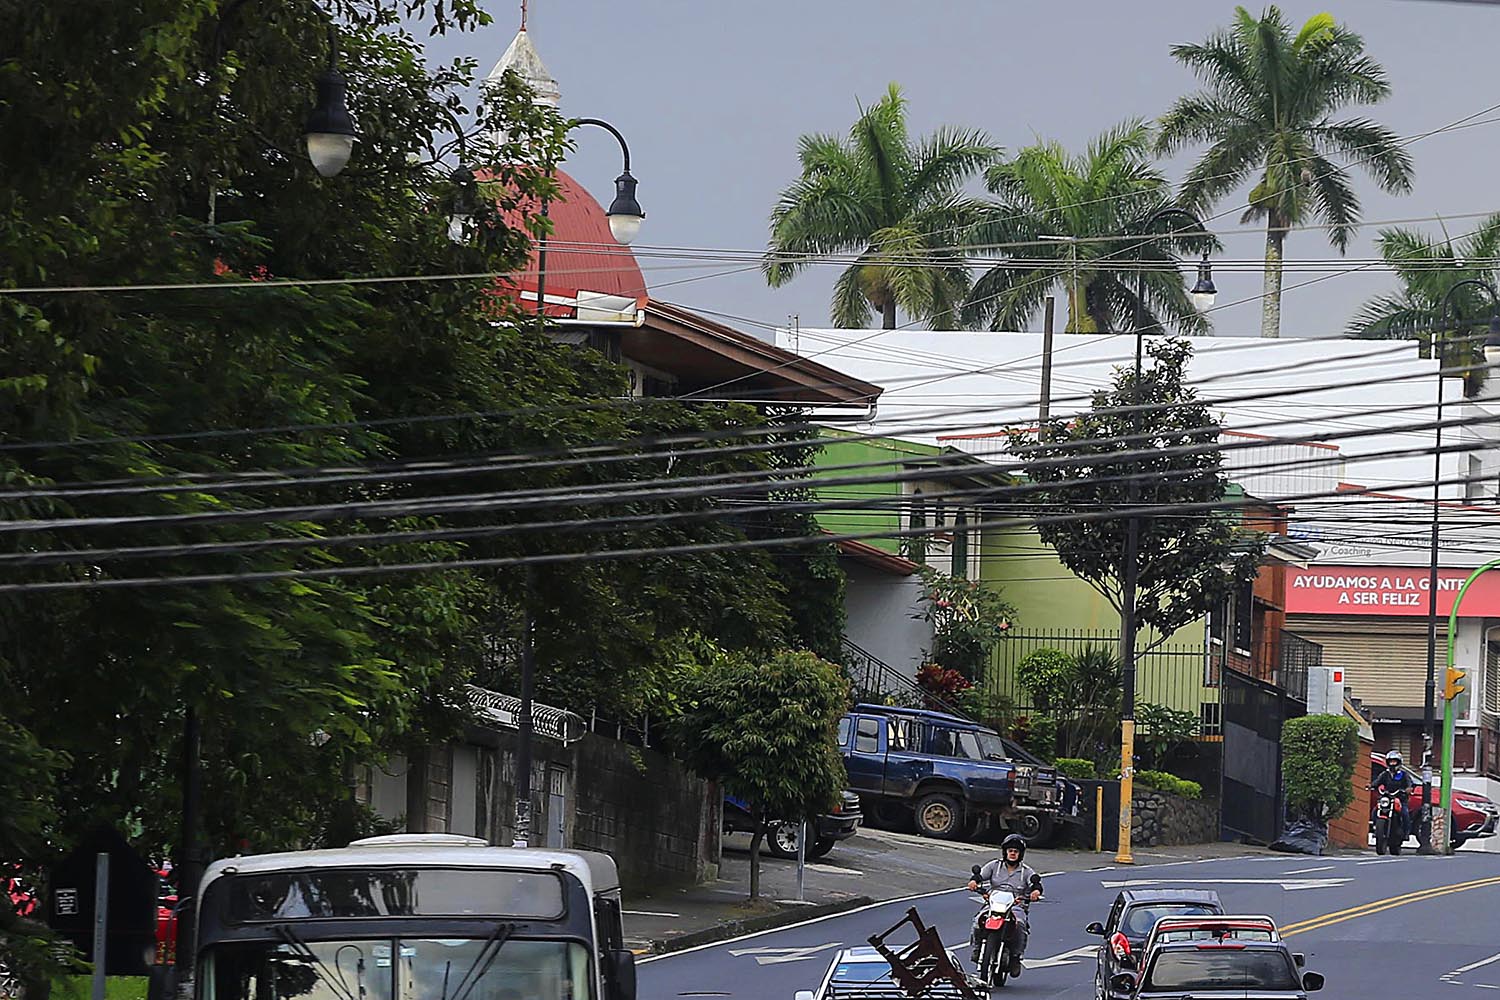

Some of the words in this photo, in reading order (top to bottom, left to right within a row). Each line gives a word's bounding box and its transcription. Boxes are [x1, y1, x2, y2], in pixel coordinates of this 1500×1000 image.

[1331, 545, 1371, 557] Coaching
[1293, 576, 1377, 589] AYUDAMOS
[1380, 577, 1393, 590] A
[1396, 578, 1415, 590] LA
[1418, 578, 1466, 591] GNT
[1338, 592, 1350, 604] A
[1353, 592, 1379, 605] SER
[1382, 593, 1420, 605] FELIZ
